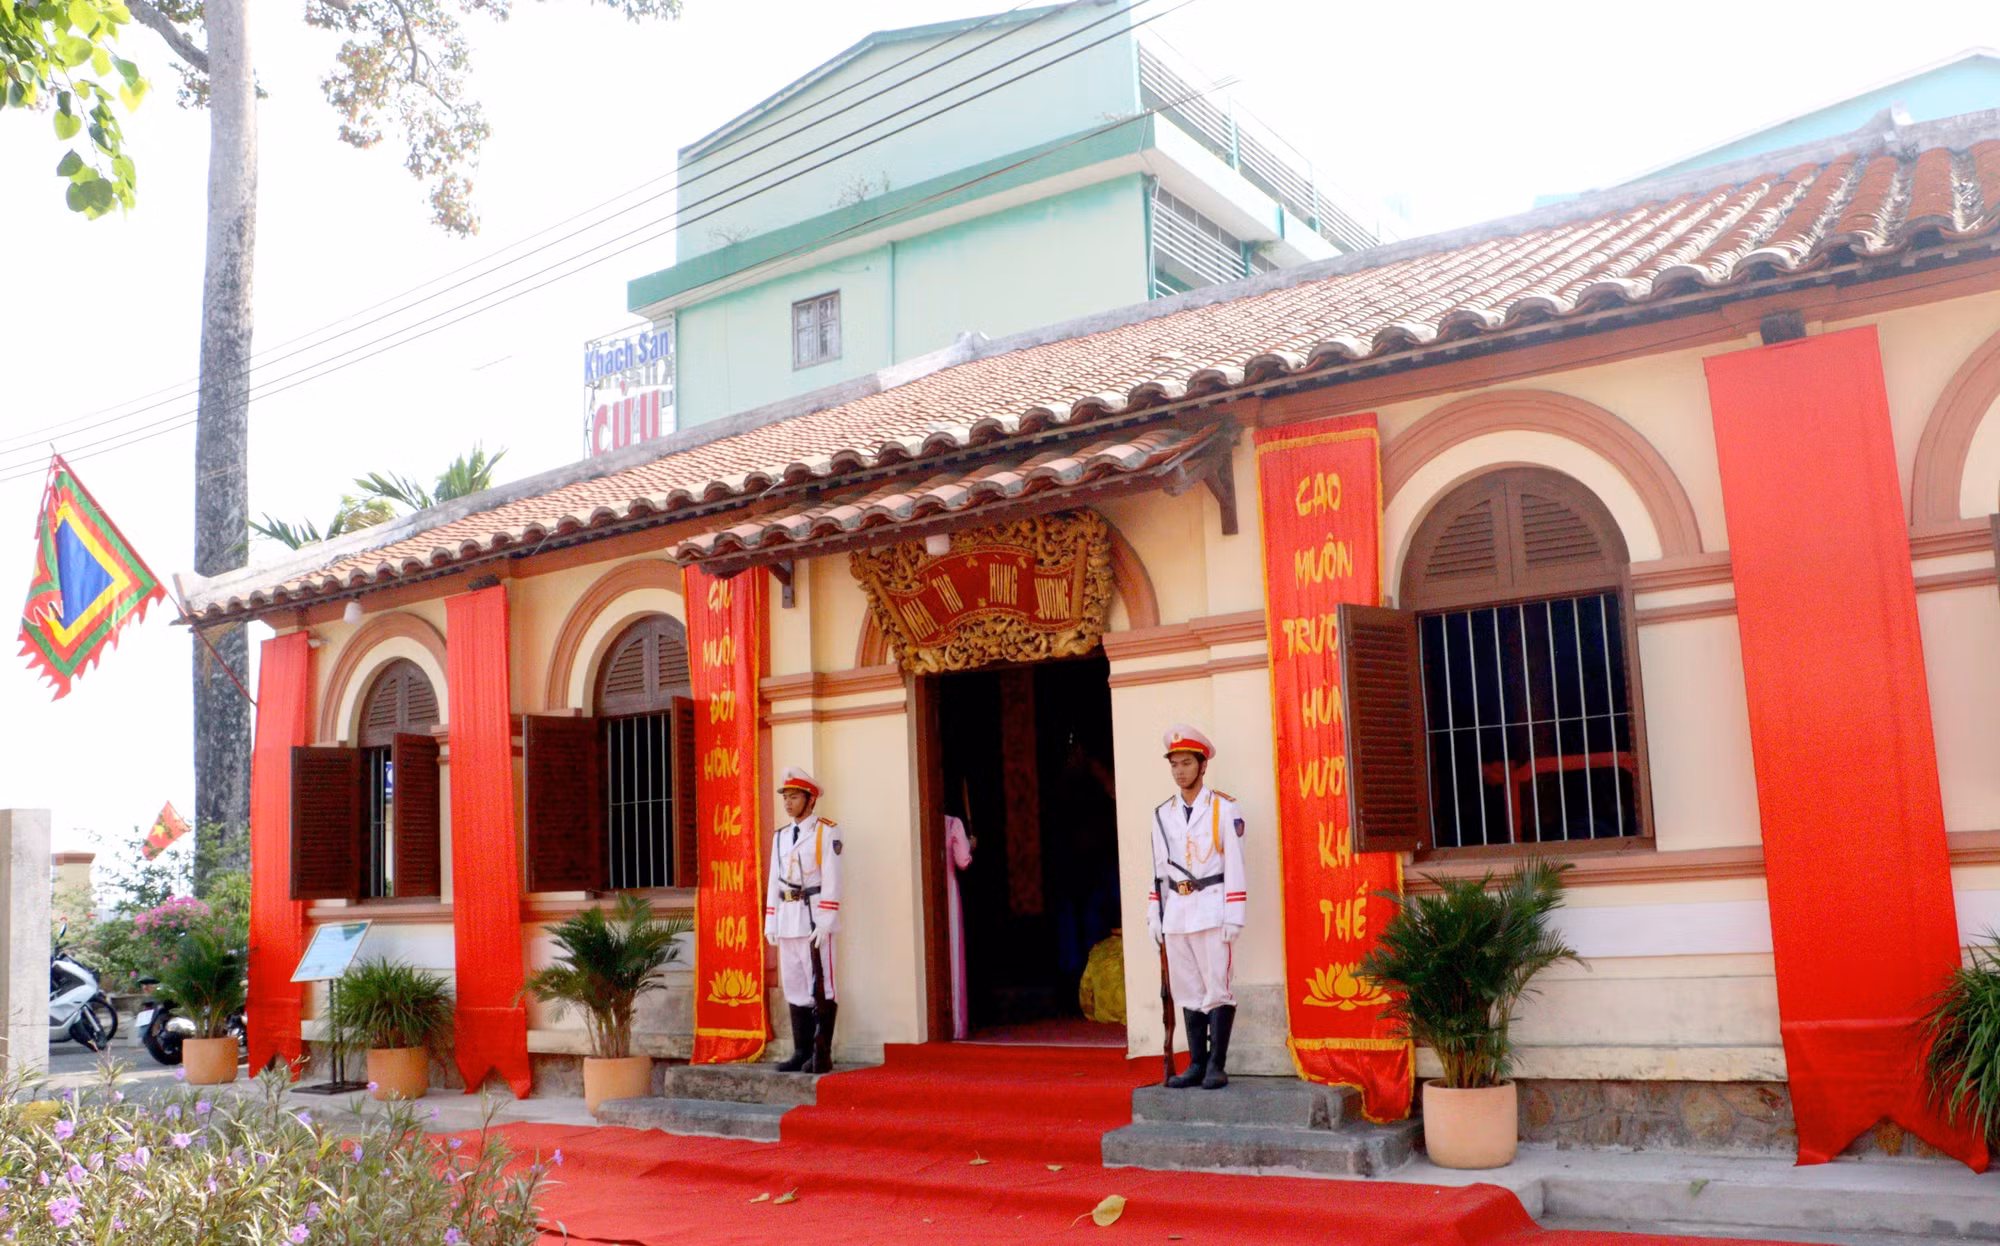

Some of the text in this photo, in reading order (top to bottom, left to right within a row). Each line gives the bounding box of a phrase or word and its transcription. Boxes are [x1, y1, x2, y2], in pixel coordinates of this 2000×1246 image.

[638, 331, 669, 367] Sạn
[1295, 472, 1342, 517] CAO
[988, 554, 1018, 606] HÙNG
[1294, 532, 1353, 590] MUÔN
[1282, 613, 1339, 660] TRƯỢ
[1302, 679, 1344, 729] HÙN
[1298, 755, 1348, 800] VƯƠ
[713, 804, 742, 845] LẠC
[711, 860, 745, 894] TINH
[715, 915, 748, 952] HOA
[1319, 880, 1369, 943] THẾ
